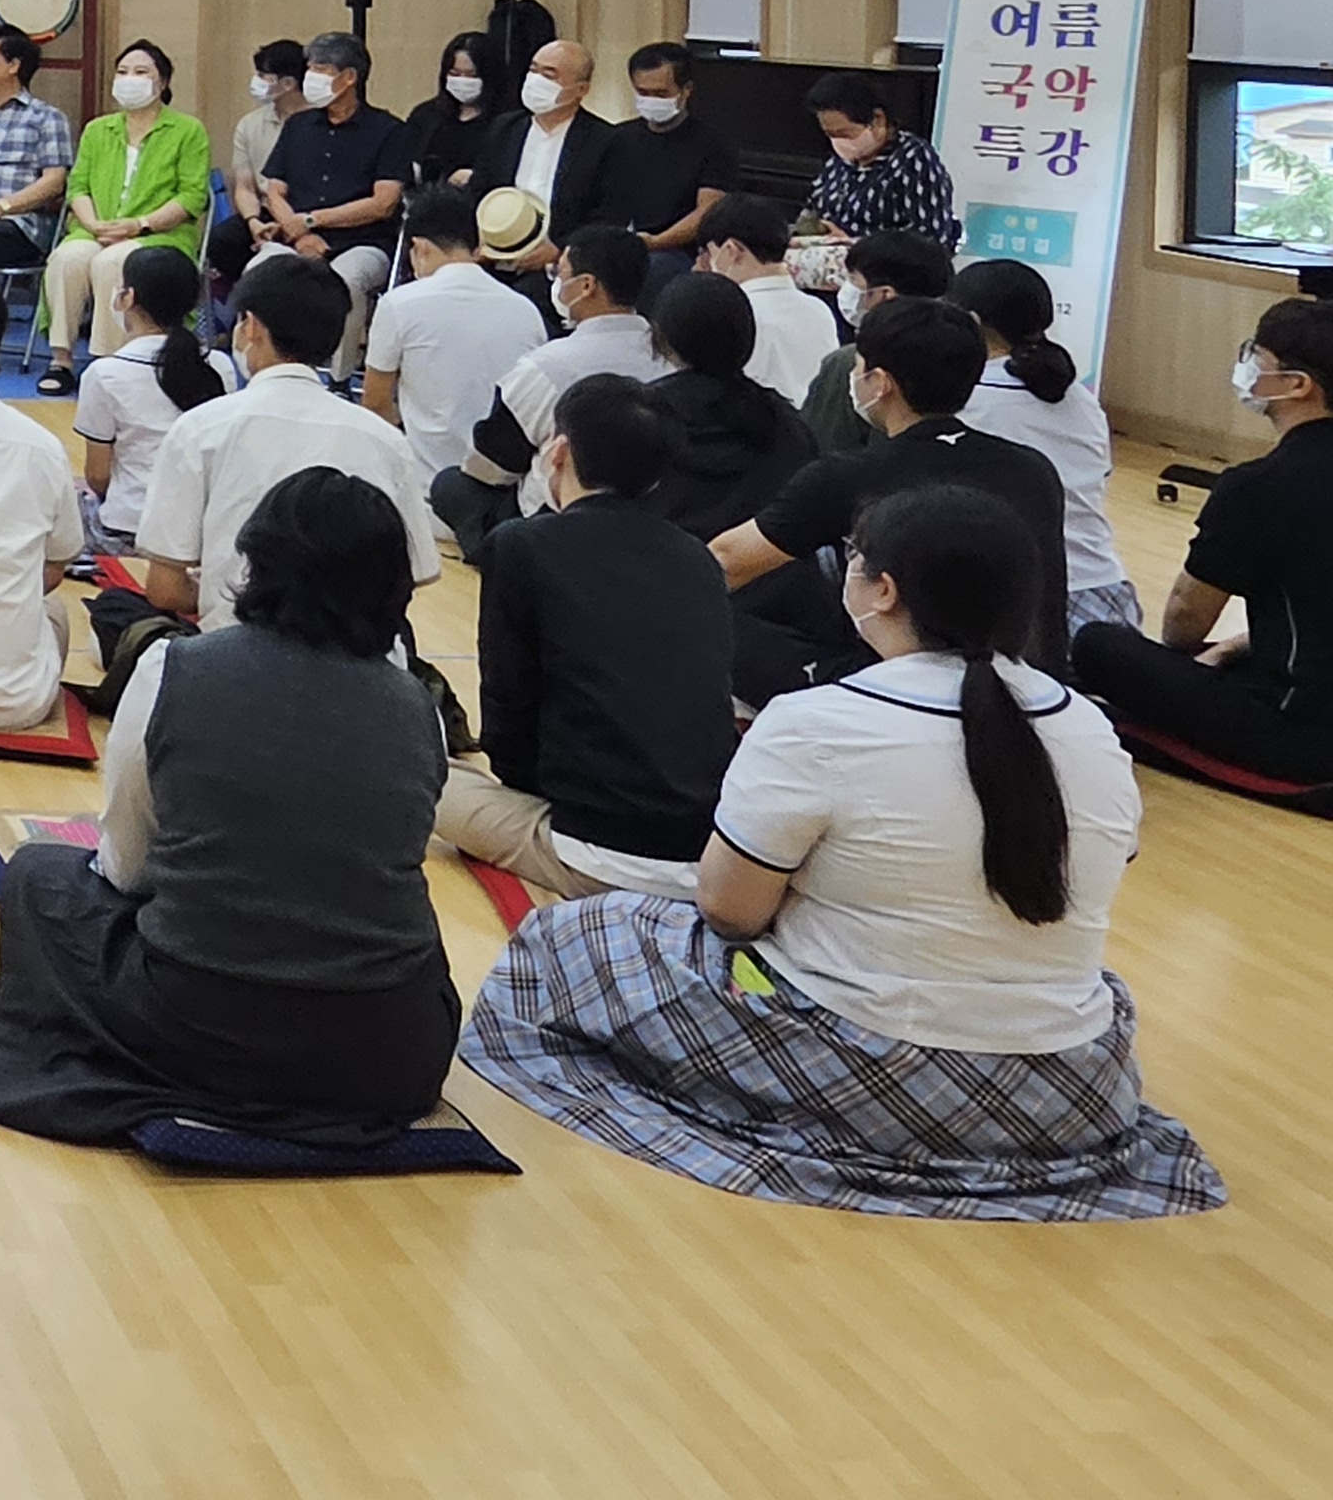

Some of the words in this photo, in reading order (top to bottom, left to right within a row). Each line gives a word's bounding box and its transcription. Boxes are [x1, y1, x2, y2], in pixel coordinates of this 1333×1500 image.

[991, 0, 1102, 48] 여름
[981, 62, 1098, 112] 국악
[973, 123, 1090, 177] 특강
